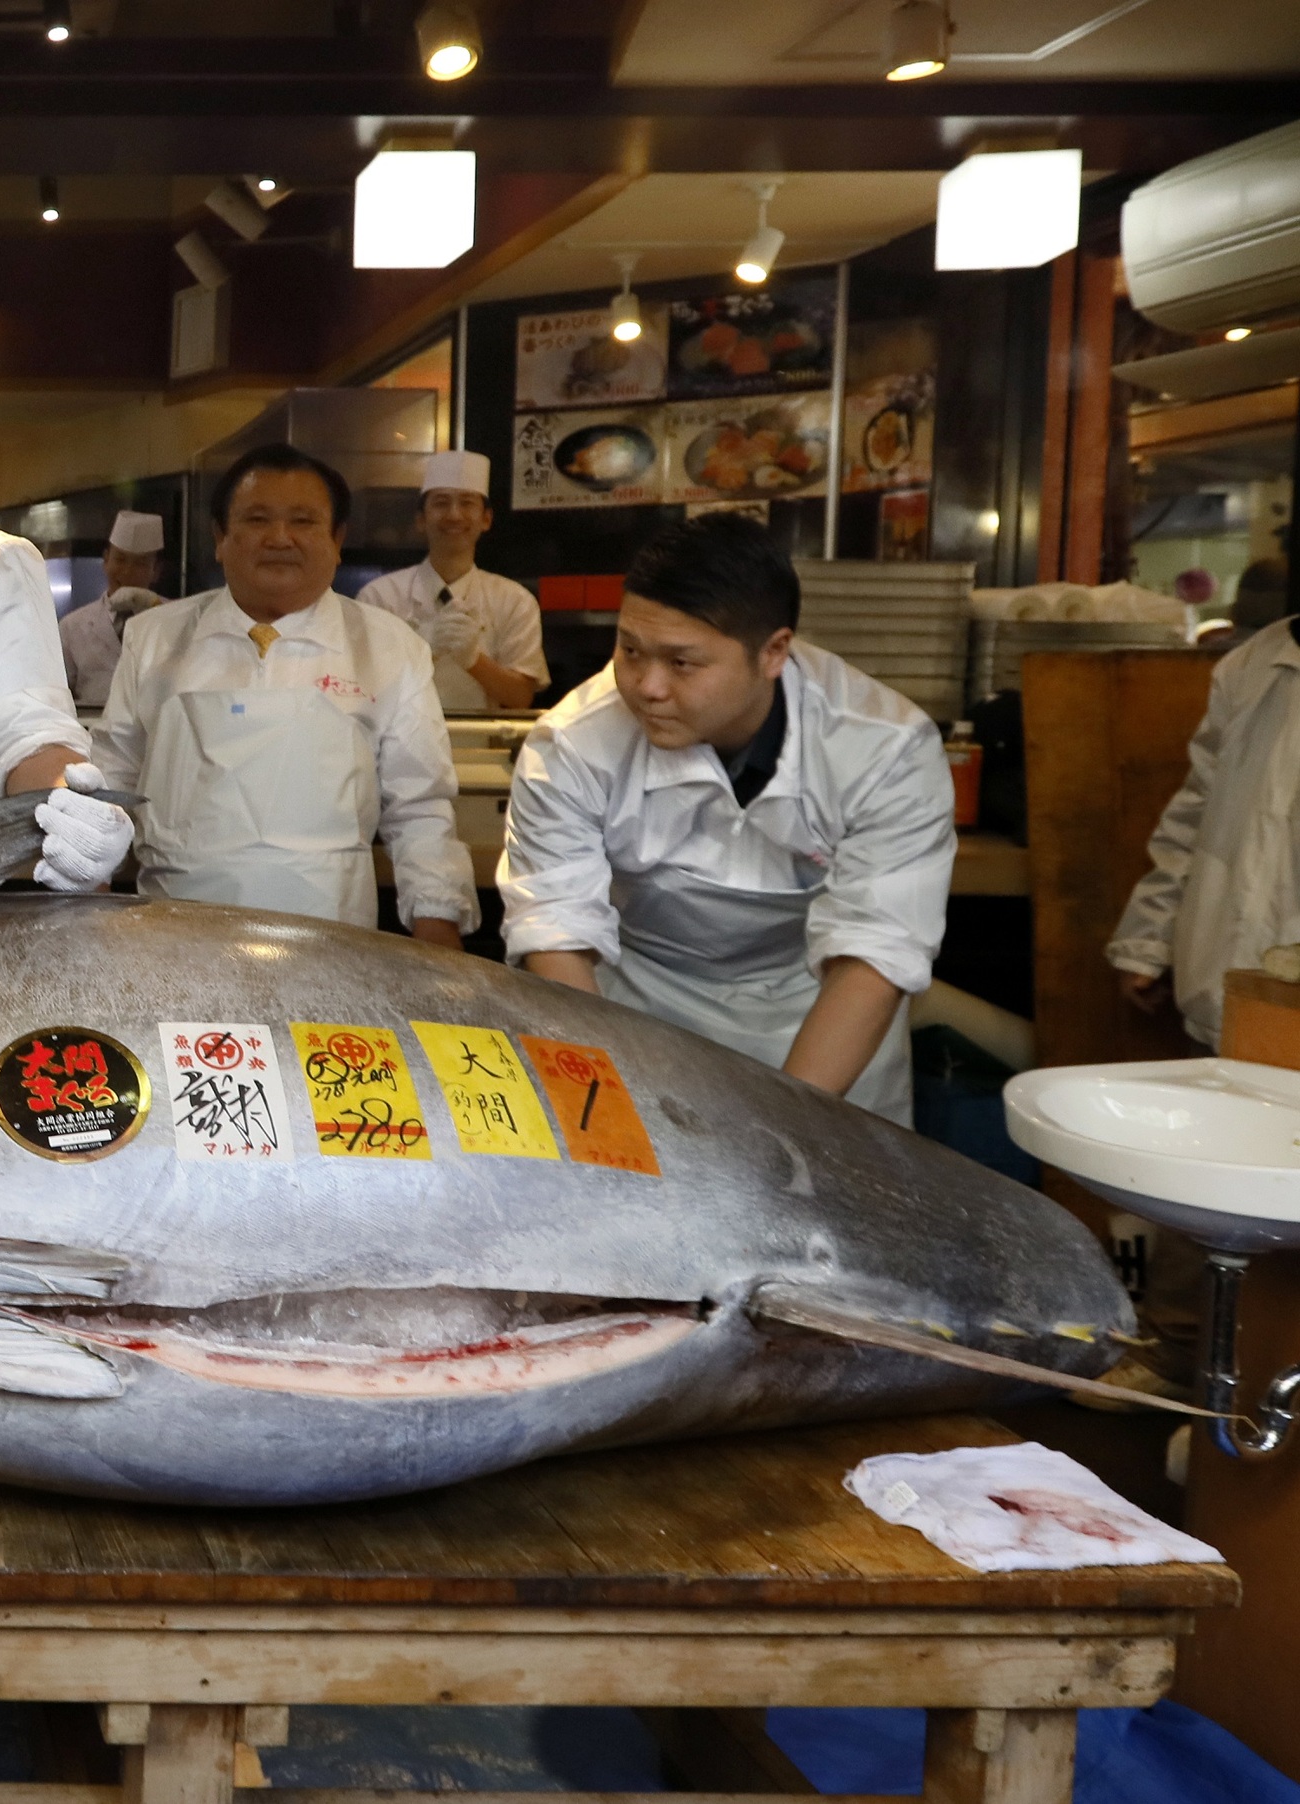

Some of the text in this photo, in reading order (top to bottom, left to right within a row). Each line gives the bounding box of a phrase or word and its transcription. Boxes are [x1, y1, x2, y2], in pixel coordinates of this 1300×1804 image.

[16, 1040, 108, 1078] 大間
[244, 1036, 267, 1071] 中央
[20, 1074, 119, 1112] まぐろ
[320, 1097, 422, 1152] 2780
[203, 1141, 272, 1156] マルナカ
